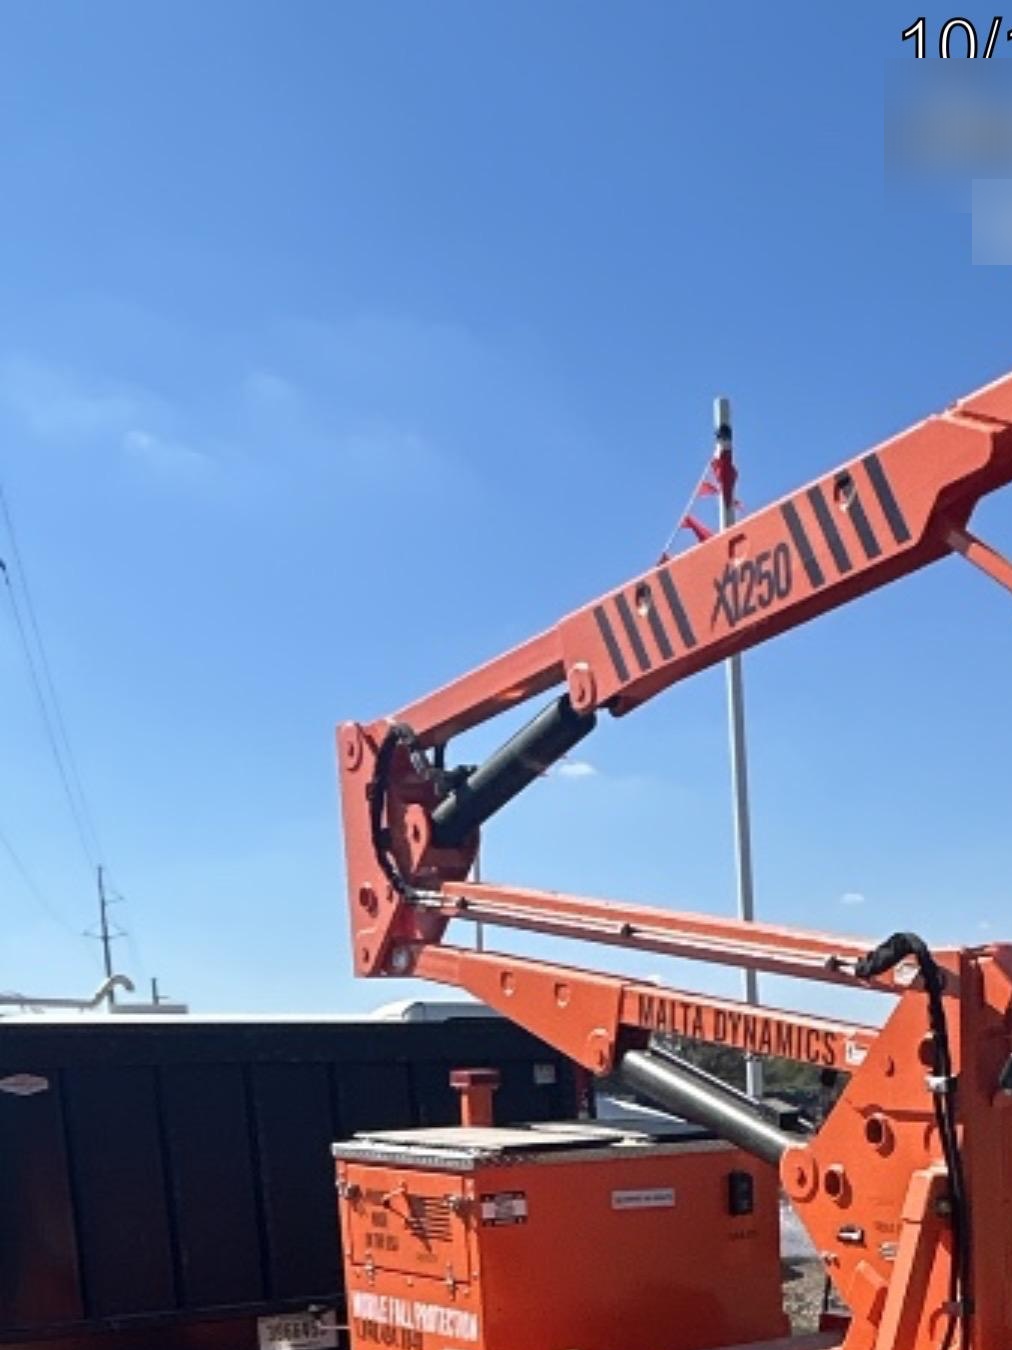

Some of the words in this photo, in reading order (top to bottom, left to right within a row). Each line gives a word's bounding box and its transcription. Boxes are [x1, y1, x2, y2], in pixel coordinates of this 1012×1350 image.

[711, 542, 793, 632] X1250
[637, 993, 704, 1038] MALTA
[713, 1009, 836, 1066] DYNAMICS
